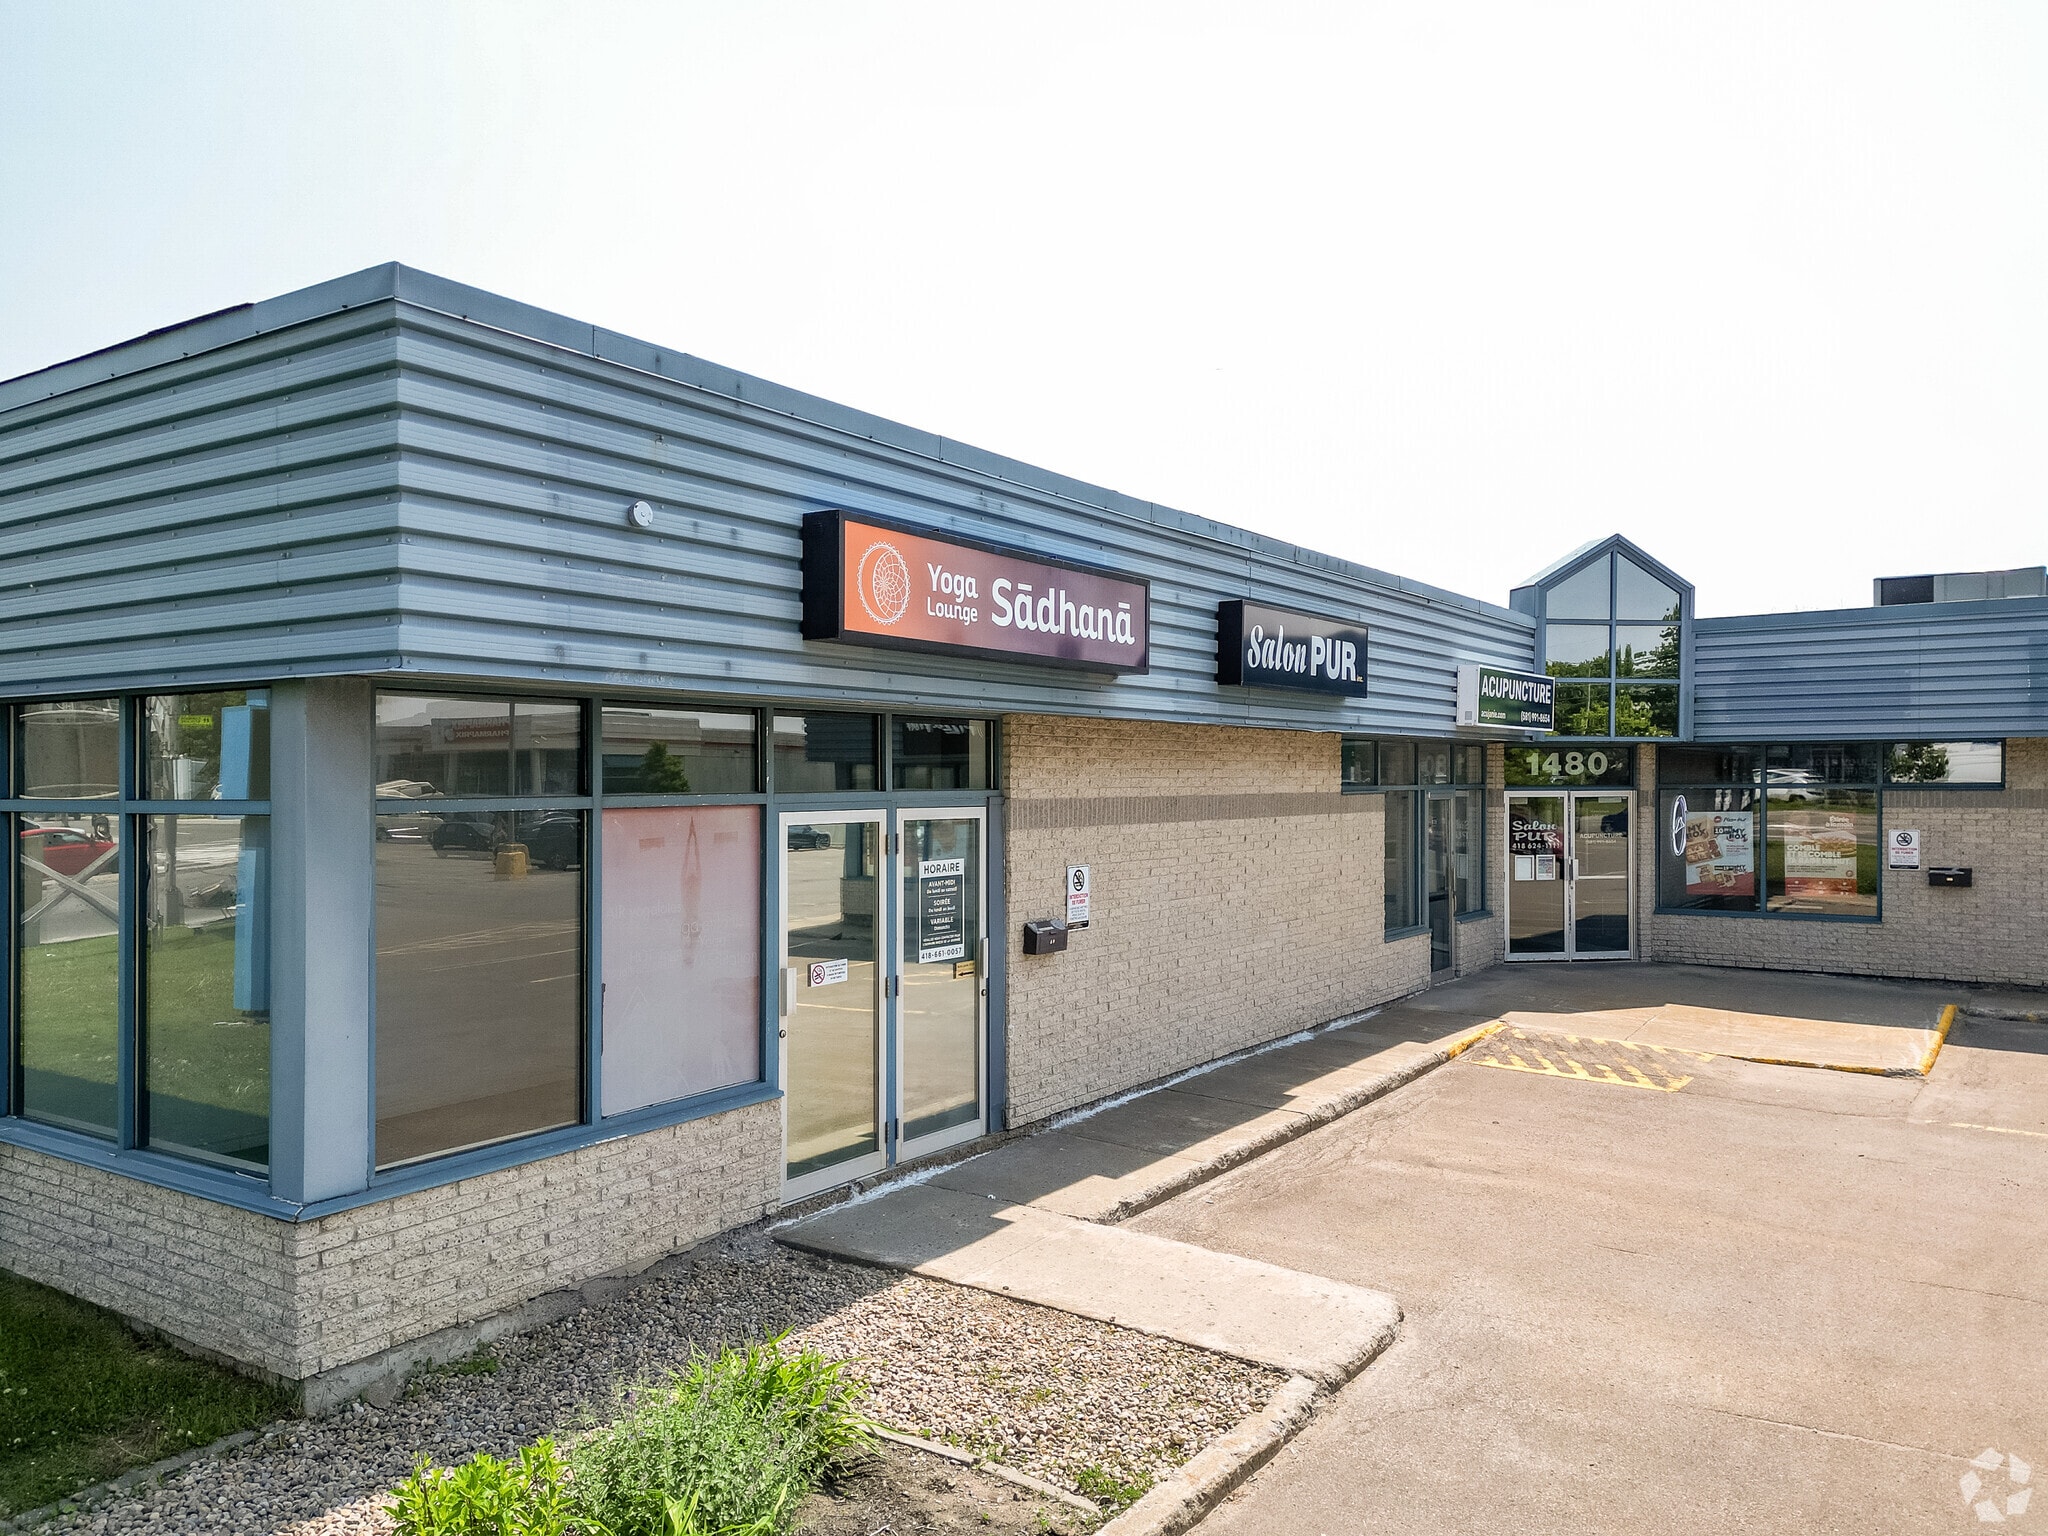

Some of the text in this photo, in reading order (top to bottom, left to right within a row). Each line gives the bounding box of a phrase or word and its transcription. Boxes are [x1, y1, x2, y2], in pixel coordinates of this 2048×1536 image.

[927, 563, 979, 603] Yoga
[927, 597, 978, 626] Lounge
[991, 578, 1135, 645] Sādhanā
[1247, 625, 1307, 674] Salon
[1310, 635, 1356, 682] PUR
[1481, 675, 1552, 705] ACUPUNCTURE
[1526, 751, 1609, 776] 1480
[1512, 820, 1557, 831] Salon
[1687, 823, 1702, 833] MY
[1512, 831, 1558, 842] PUR
[923, 862, 960, 875] HORAIRE
[928, 880, 956, 888] AVANT-MIDI
[933, 898, 951, 906] SOIRÉE
[930, 916, 954, 925] VARIABLE
[921, 947, 962, 960] 418-661-0057
